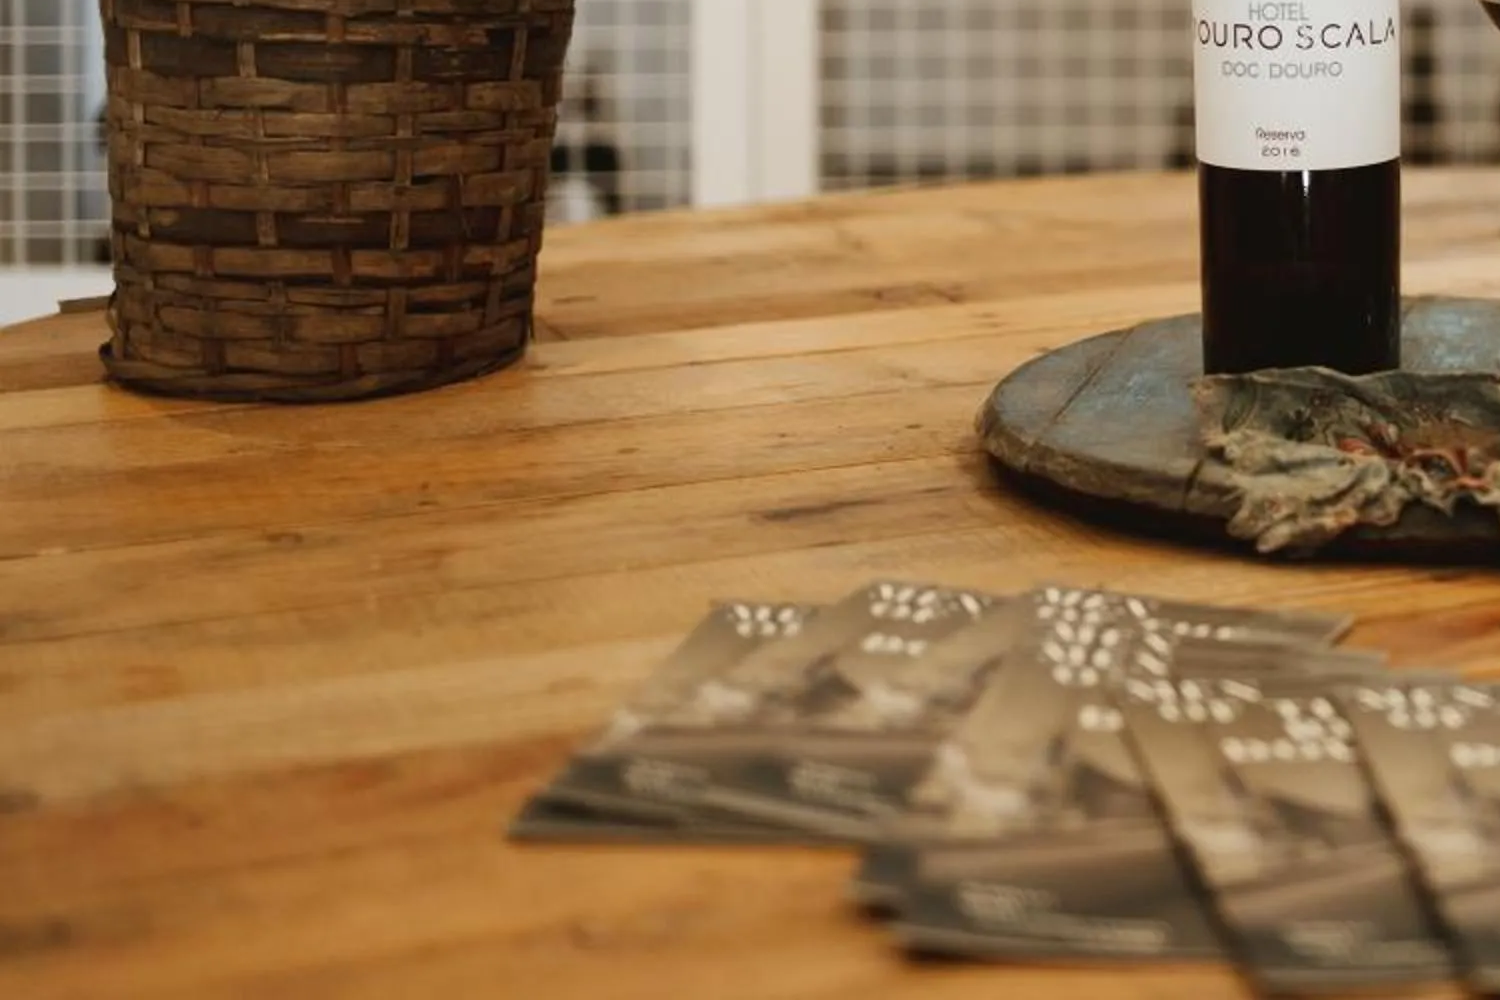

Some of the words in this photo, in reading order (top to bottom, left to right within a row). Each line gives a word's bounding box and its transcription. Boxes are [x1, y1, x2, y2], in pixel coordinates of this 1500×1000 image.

[1248, 2, 1310, 22] HOTEL
[1194, 18, 1283, 50] OURO
[1296, 17, 1395, 50] SCALA
[1222, 60, 1260, 79] DOC
[1268, 60, 1343, 80] DOURO
[1255, 126, 1306, 142] Reserva
